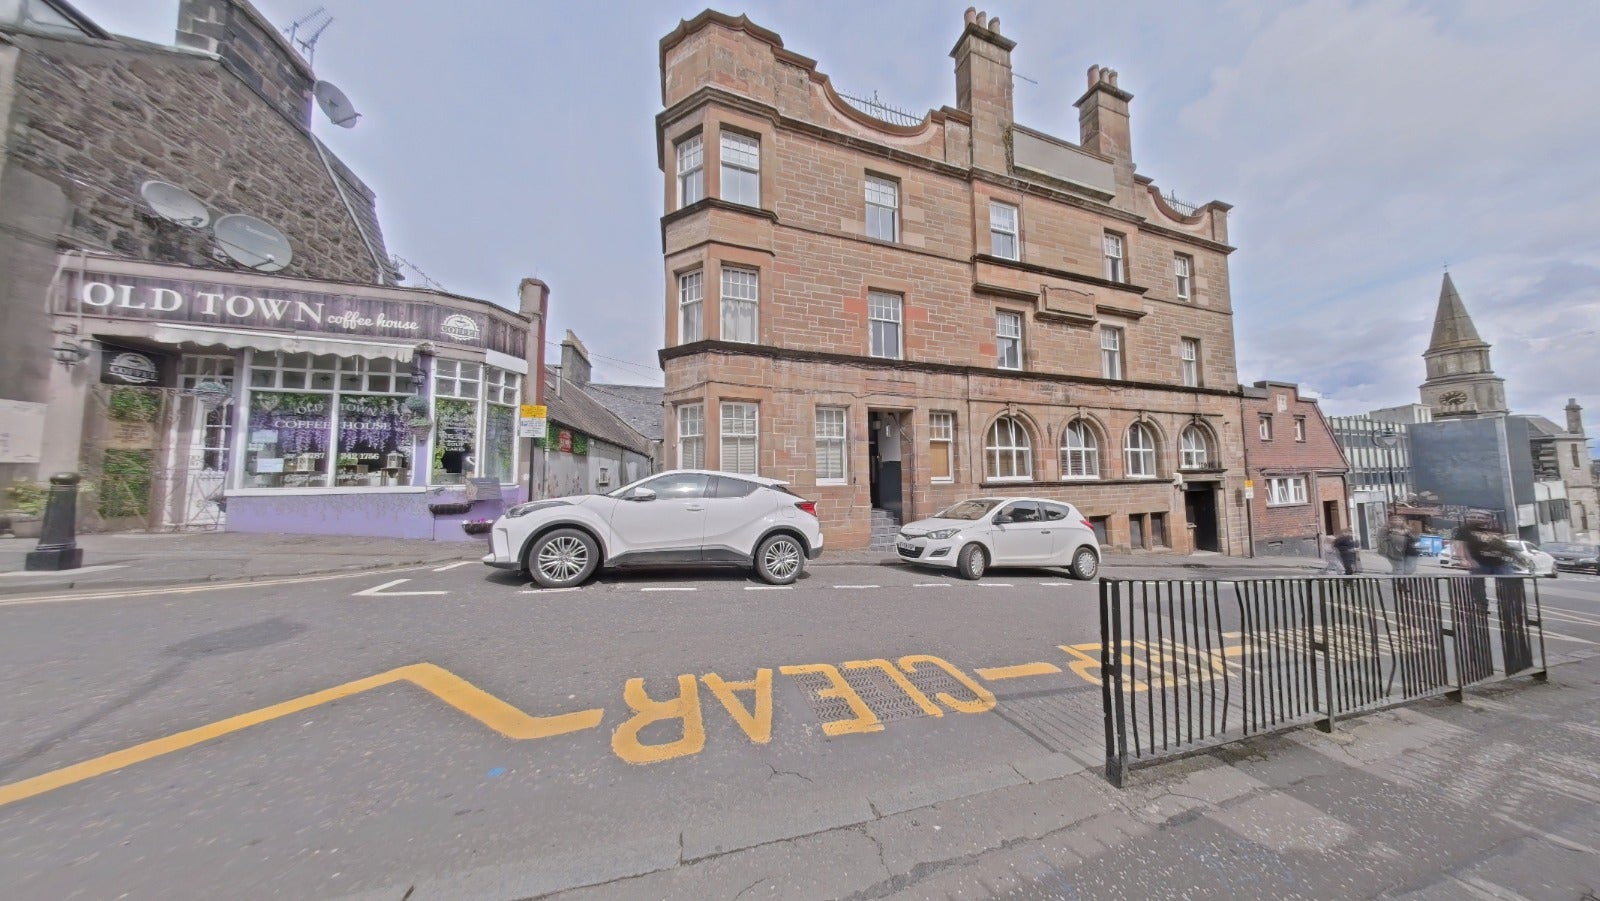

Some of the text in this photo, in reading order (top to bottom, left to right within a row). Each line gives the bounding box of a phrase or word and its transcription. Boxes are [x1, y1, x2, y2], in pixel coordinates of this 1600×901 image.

[83, 282, 325, 324] OLD TOWN
[327, 311, 419, 330] coffee house
[296, 401, 378, 416] OLD TOWN
[274, 420, 391, 430] COFFEE HOUSE
[612, 655, 997, 764] CLEAR
